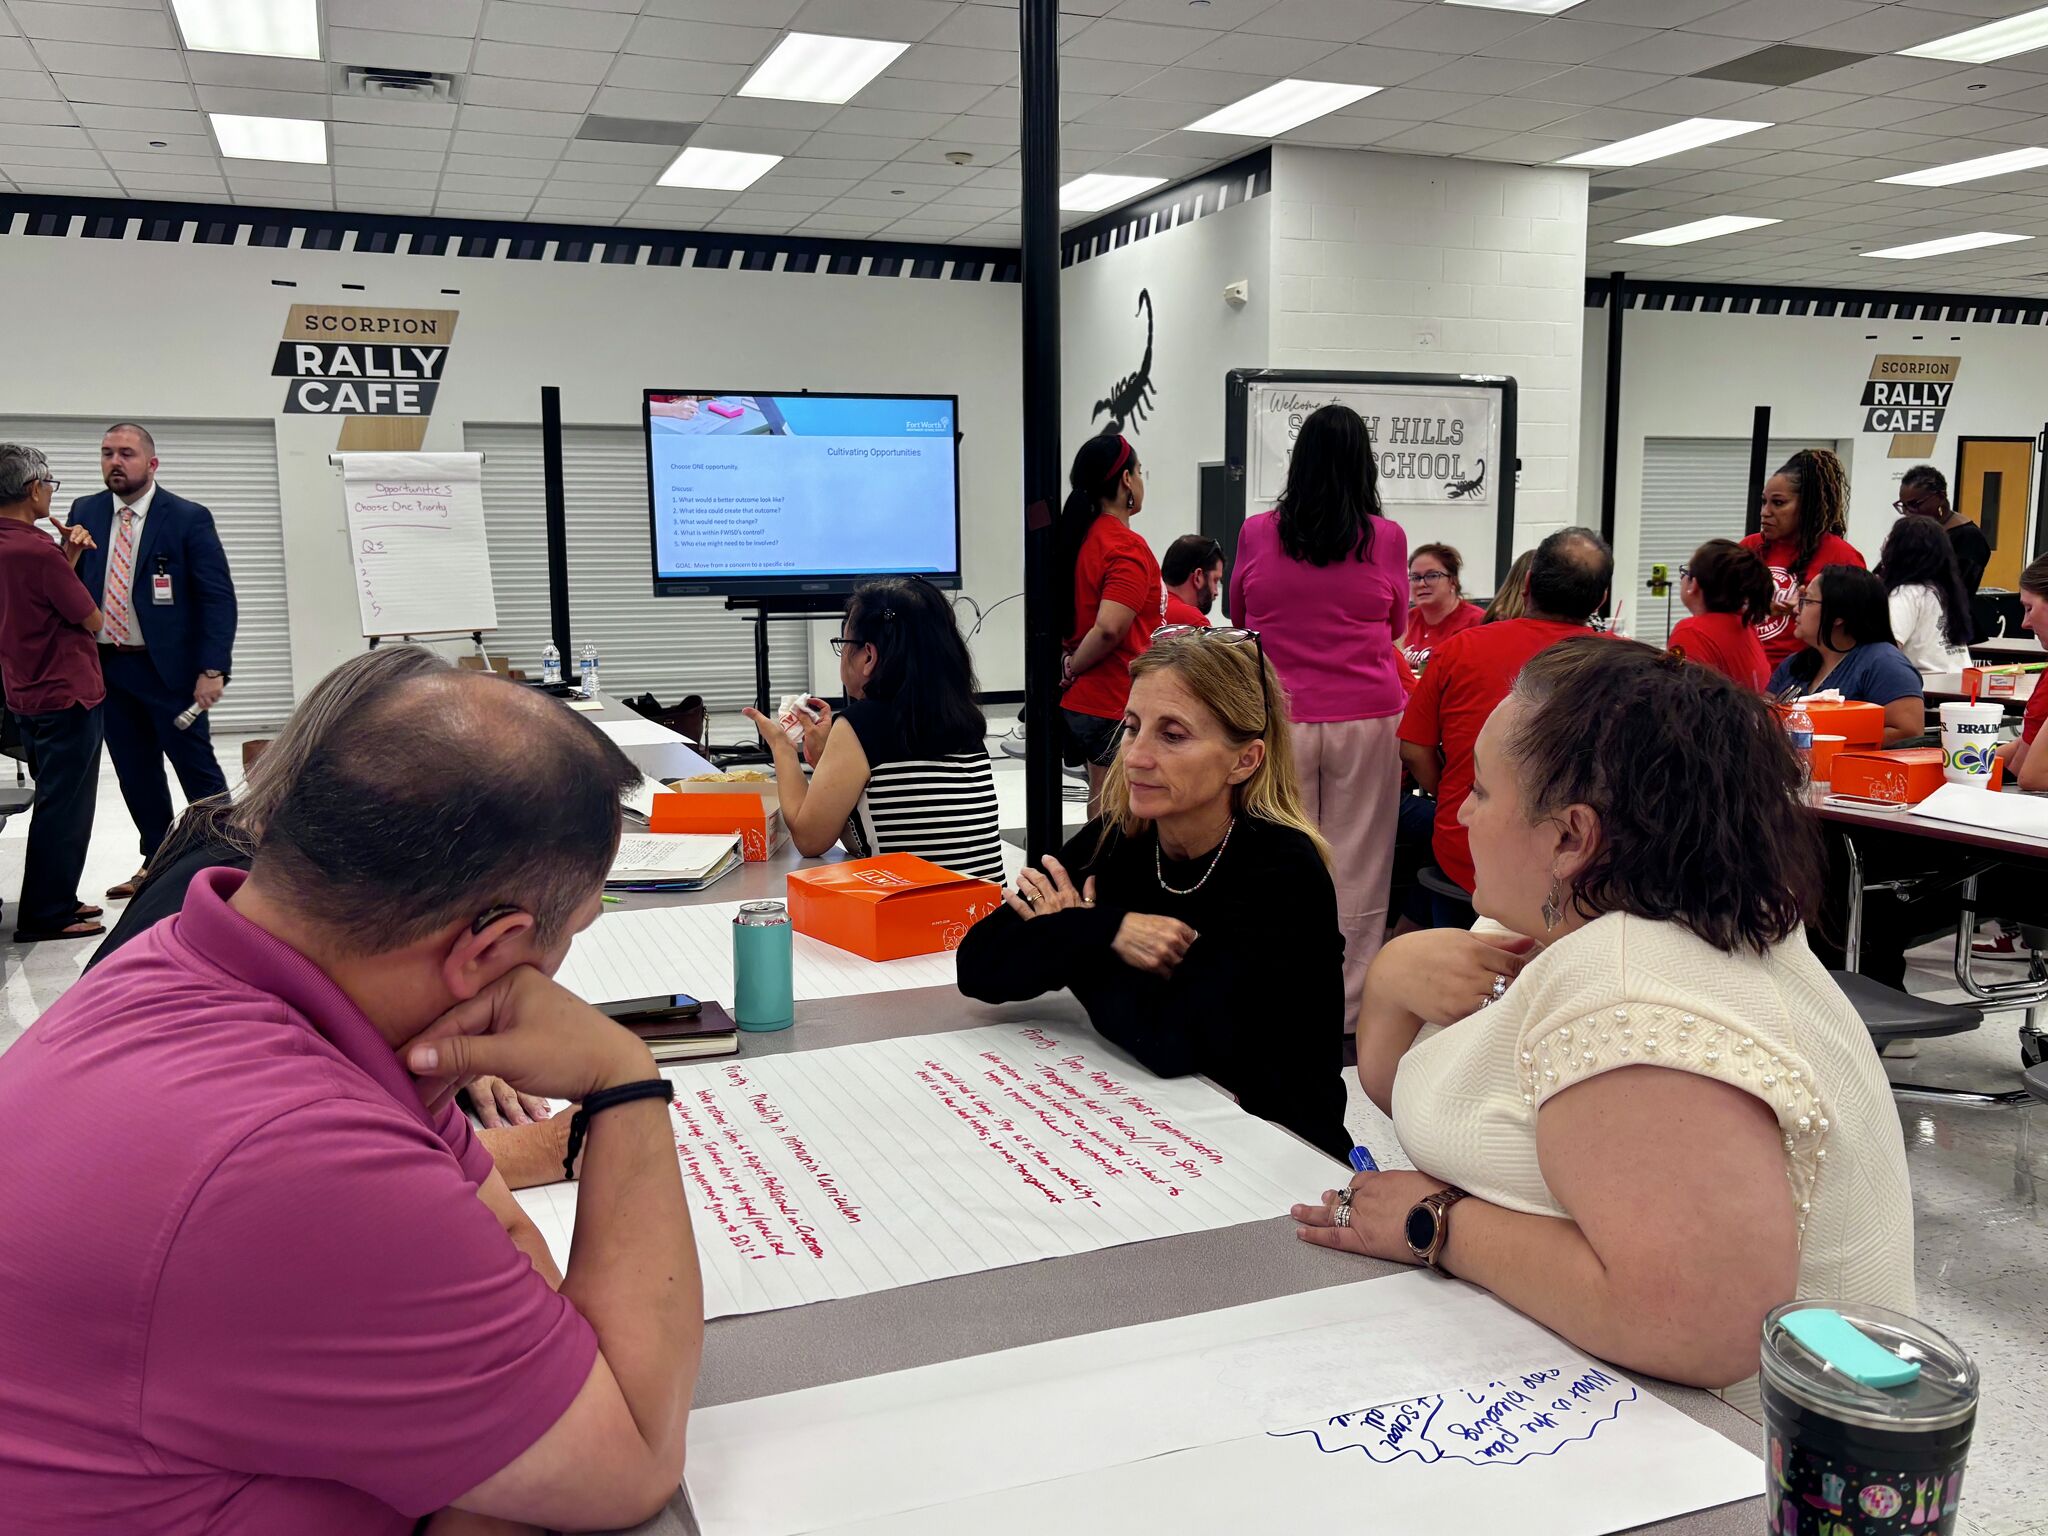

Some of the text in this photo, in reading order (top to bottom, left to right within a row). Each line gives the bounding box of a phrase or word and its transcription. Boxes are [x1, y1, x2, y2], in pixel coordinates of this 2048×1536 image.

[305, 314, 437, 336] SCORPION
[295, 344, 443, 379] RALLY
[1881, 361, 1950, 377] SCORPION
[298, 381, 422, 414] CAFE
[1269, 391, 1320, 413] Welcome
[1873, 382, 1951, 406] RALLY
[921, 421, 941, 429] Worth
[1389, 417, 1464, 445] HILLS
[1871, 408, 1937, 432] CAFE
[827, 447, 921, 457] Cultivating Opportunities
[1372, 451, 1465, 480] CHOOL
[355, 500, 448, 518] Choose One Priority
[735, 518, 758, 526] change?
[707, 540, 723, 548] might
[763, 561, 783, 569] specific
[1568, 1368, 1618, 1403] What
[1360, 1408, 1386, 1433] all
[1449, 1389, 1535, 1442] bleeding
[1520, 1412, 1560, 1435] the
[1475, 1427, 1520, 1458] plan
